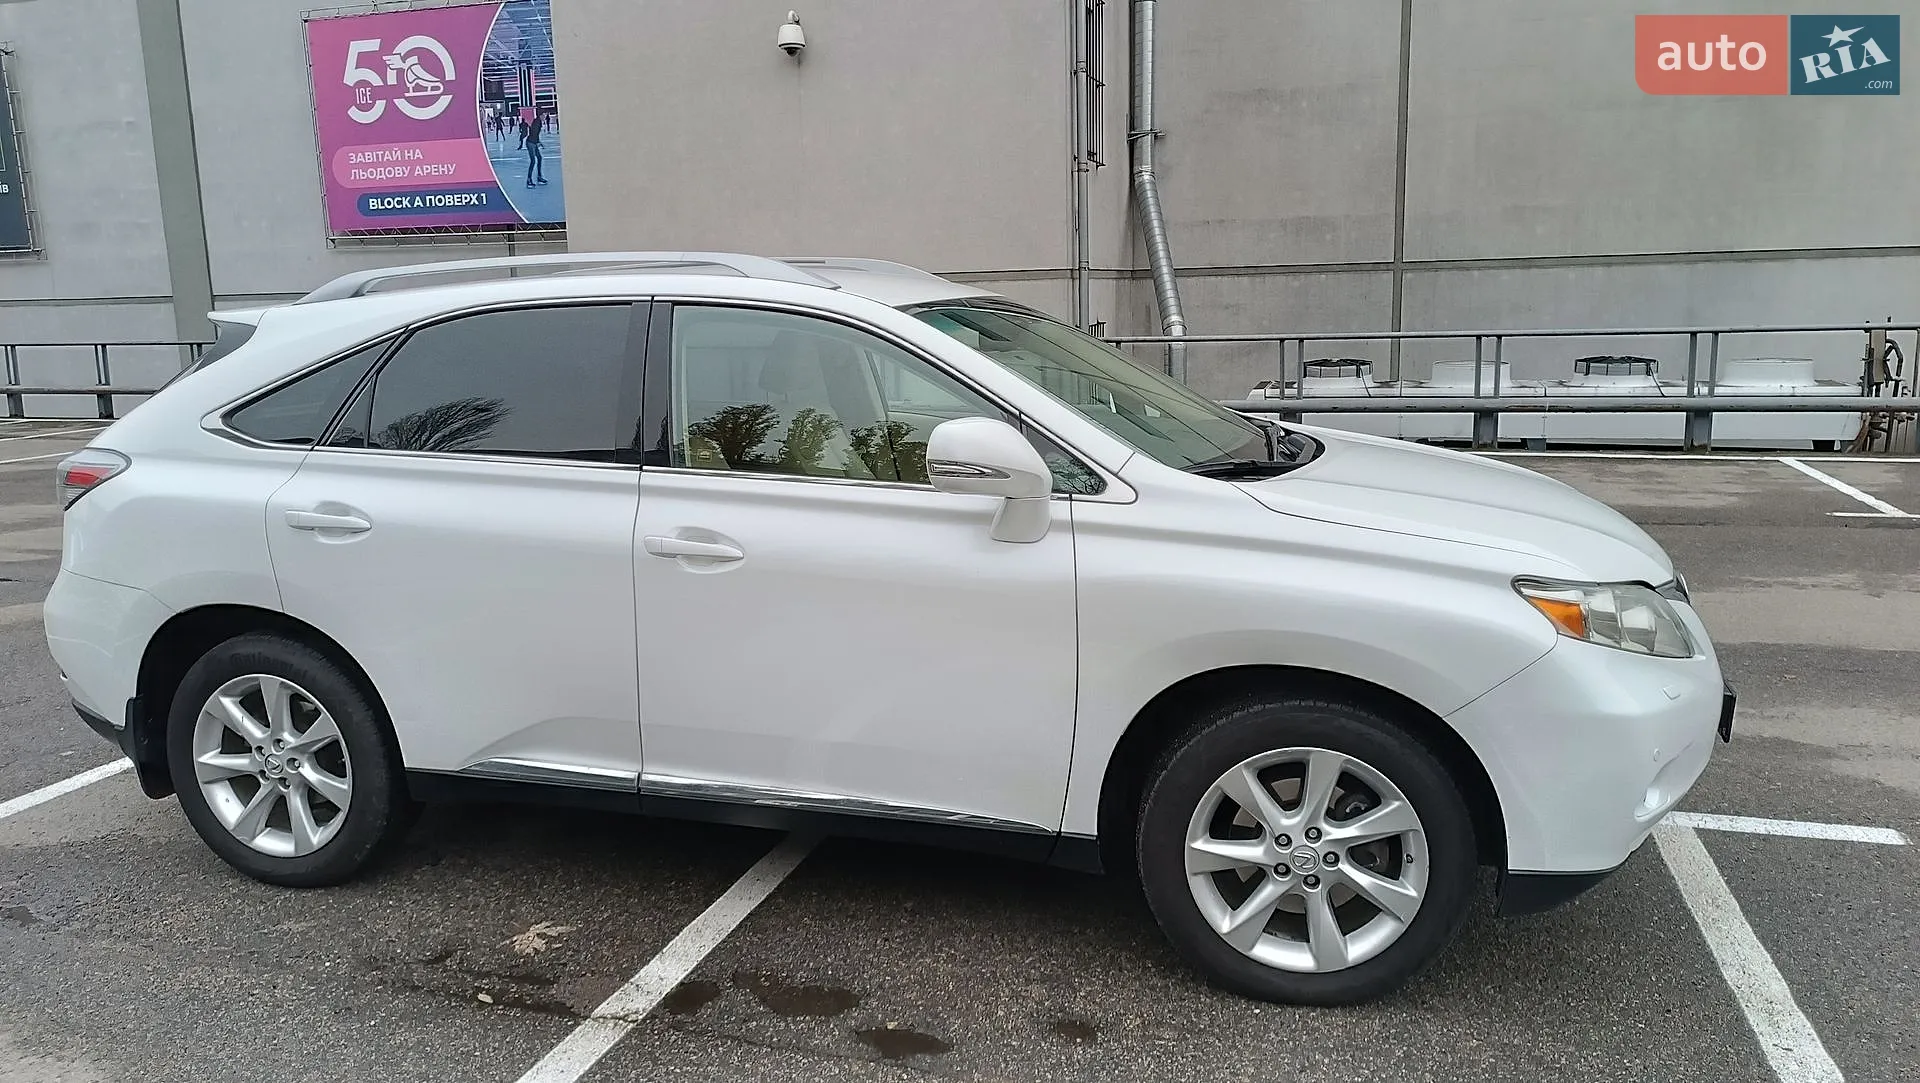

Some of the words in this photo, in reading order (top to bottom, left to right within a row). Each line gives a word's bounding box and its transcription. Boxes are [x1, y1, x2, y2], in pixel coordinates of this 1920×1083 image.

[355, 87, 373, 105] ICE
[348, 147, 401, 164] ЗАВІТАЙ
[404, 148, 424, 160] НА
[351, 165, 411, 180] ЛЬОДОВУ
[414, 163, 456, 177] АРЕНУ
[369, 196, 412, 210] BLOCK
[426, 193, 480, 207] ПОВЕРХ
[481, 193, 488, 205] 1
